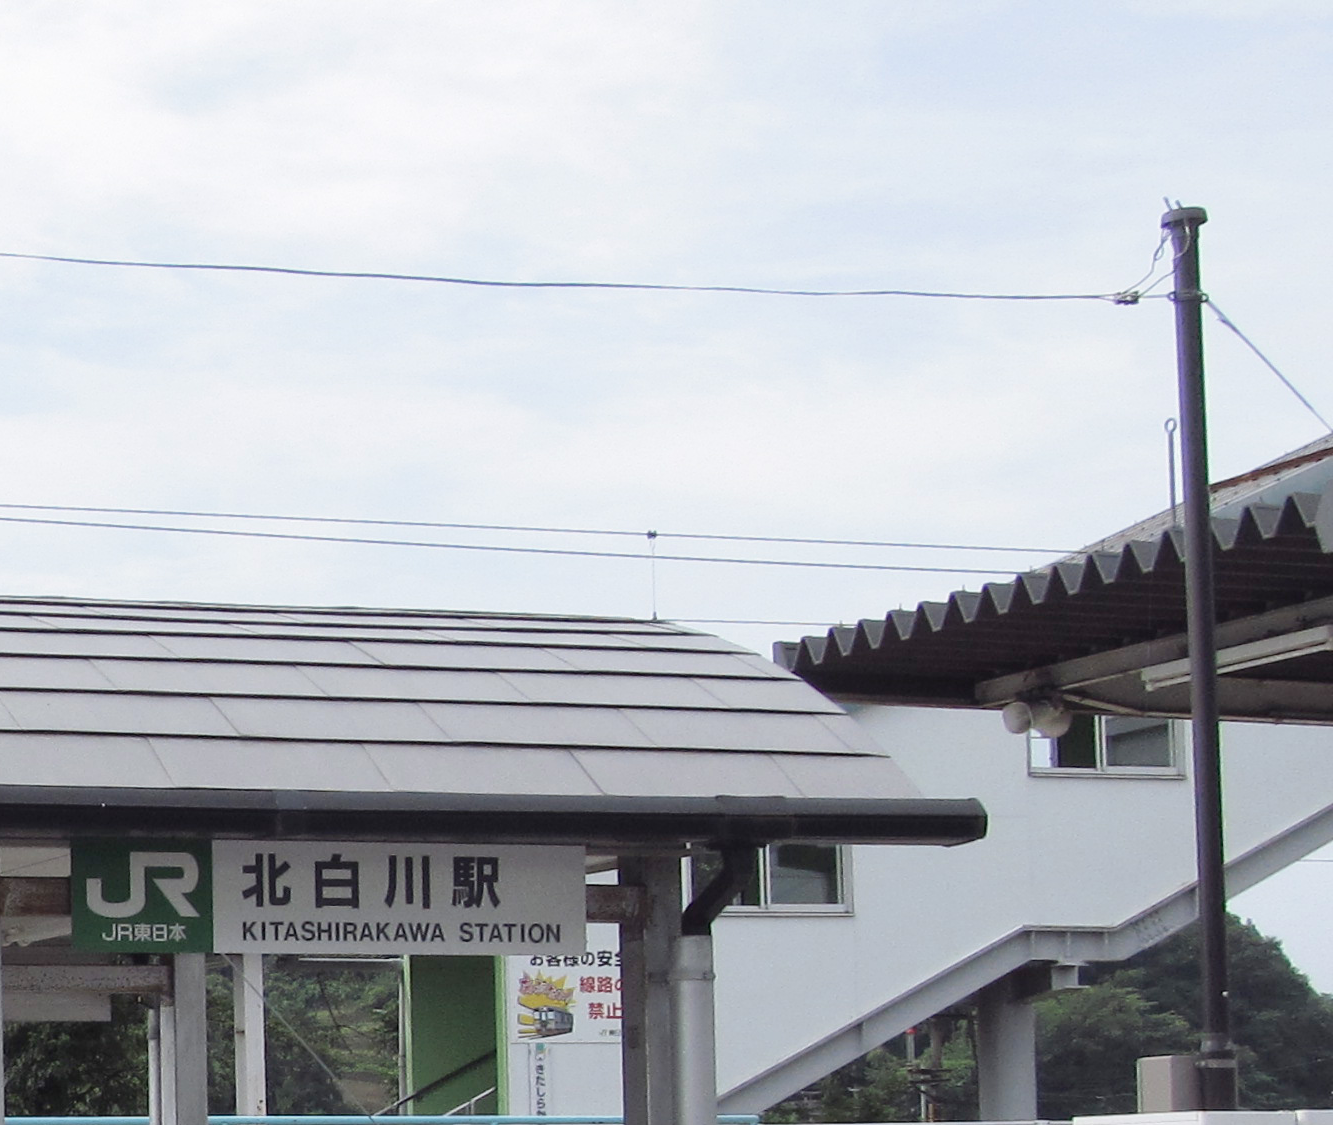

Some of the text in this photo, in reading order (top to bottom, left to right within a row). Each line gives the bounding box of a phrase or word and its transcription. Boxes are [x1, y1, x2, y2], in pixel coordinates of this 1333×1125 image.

[86, 851, 200, 917] JR
[242, 853, 501, 909] 北白川駅
[102, 924, 186, 943] JR東日本
[242, 920, 562, 944] KITASHIRAKAWA STATION
